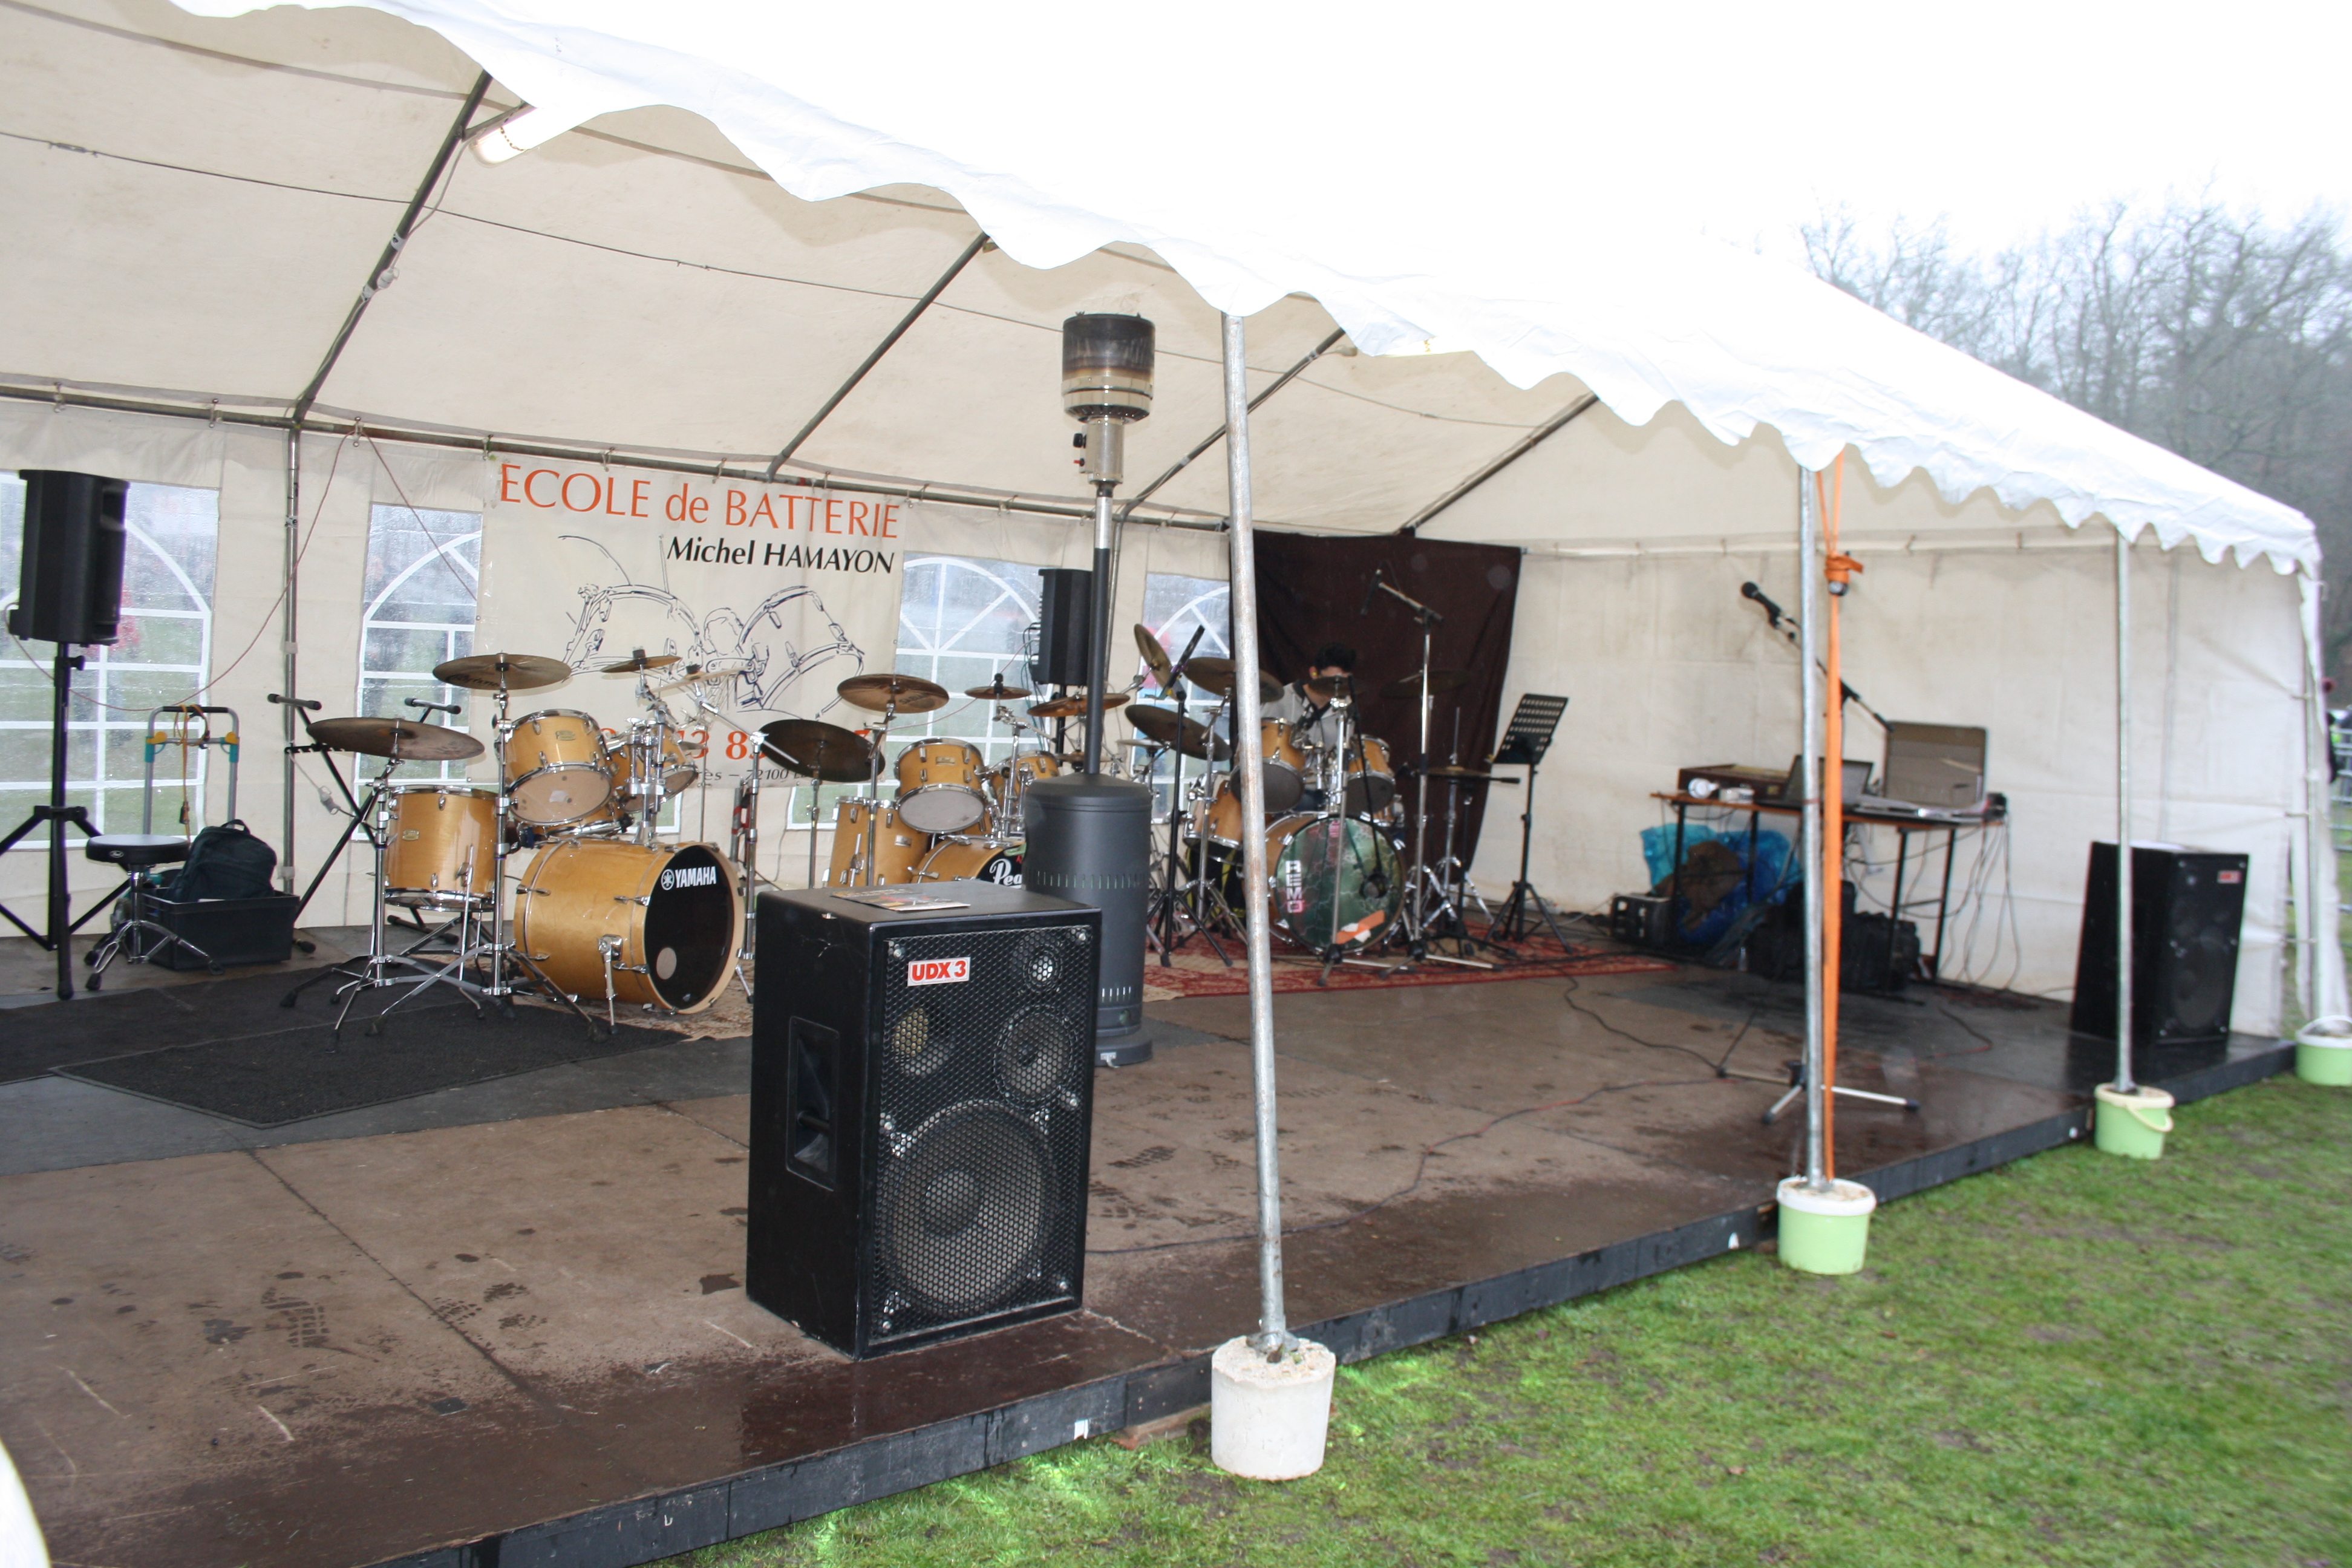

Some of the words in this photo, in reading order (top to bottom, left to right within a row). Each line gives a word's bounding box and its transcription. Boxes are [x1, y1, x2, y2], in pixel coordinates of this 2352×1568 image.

[500, 463, 652, 518] ECOLE
[665, 483, 709, 523] de
[725, 489, 900, 539] BATTERIE
[667, 536, 756, 565] Michel
[763, 543, 895, 574] HAMAYON
[675, 866, 717, 888] YAMAHA
[989, 858, 1022, 887] Pea
[1285, 860, 1304, 913] REMO
[912, 962, 952, 981] UDX
[954, 960, 966, 978] 3
